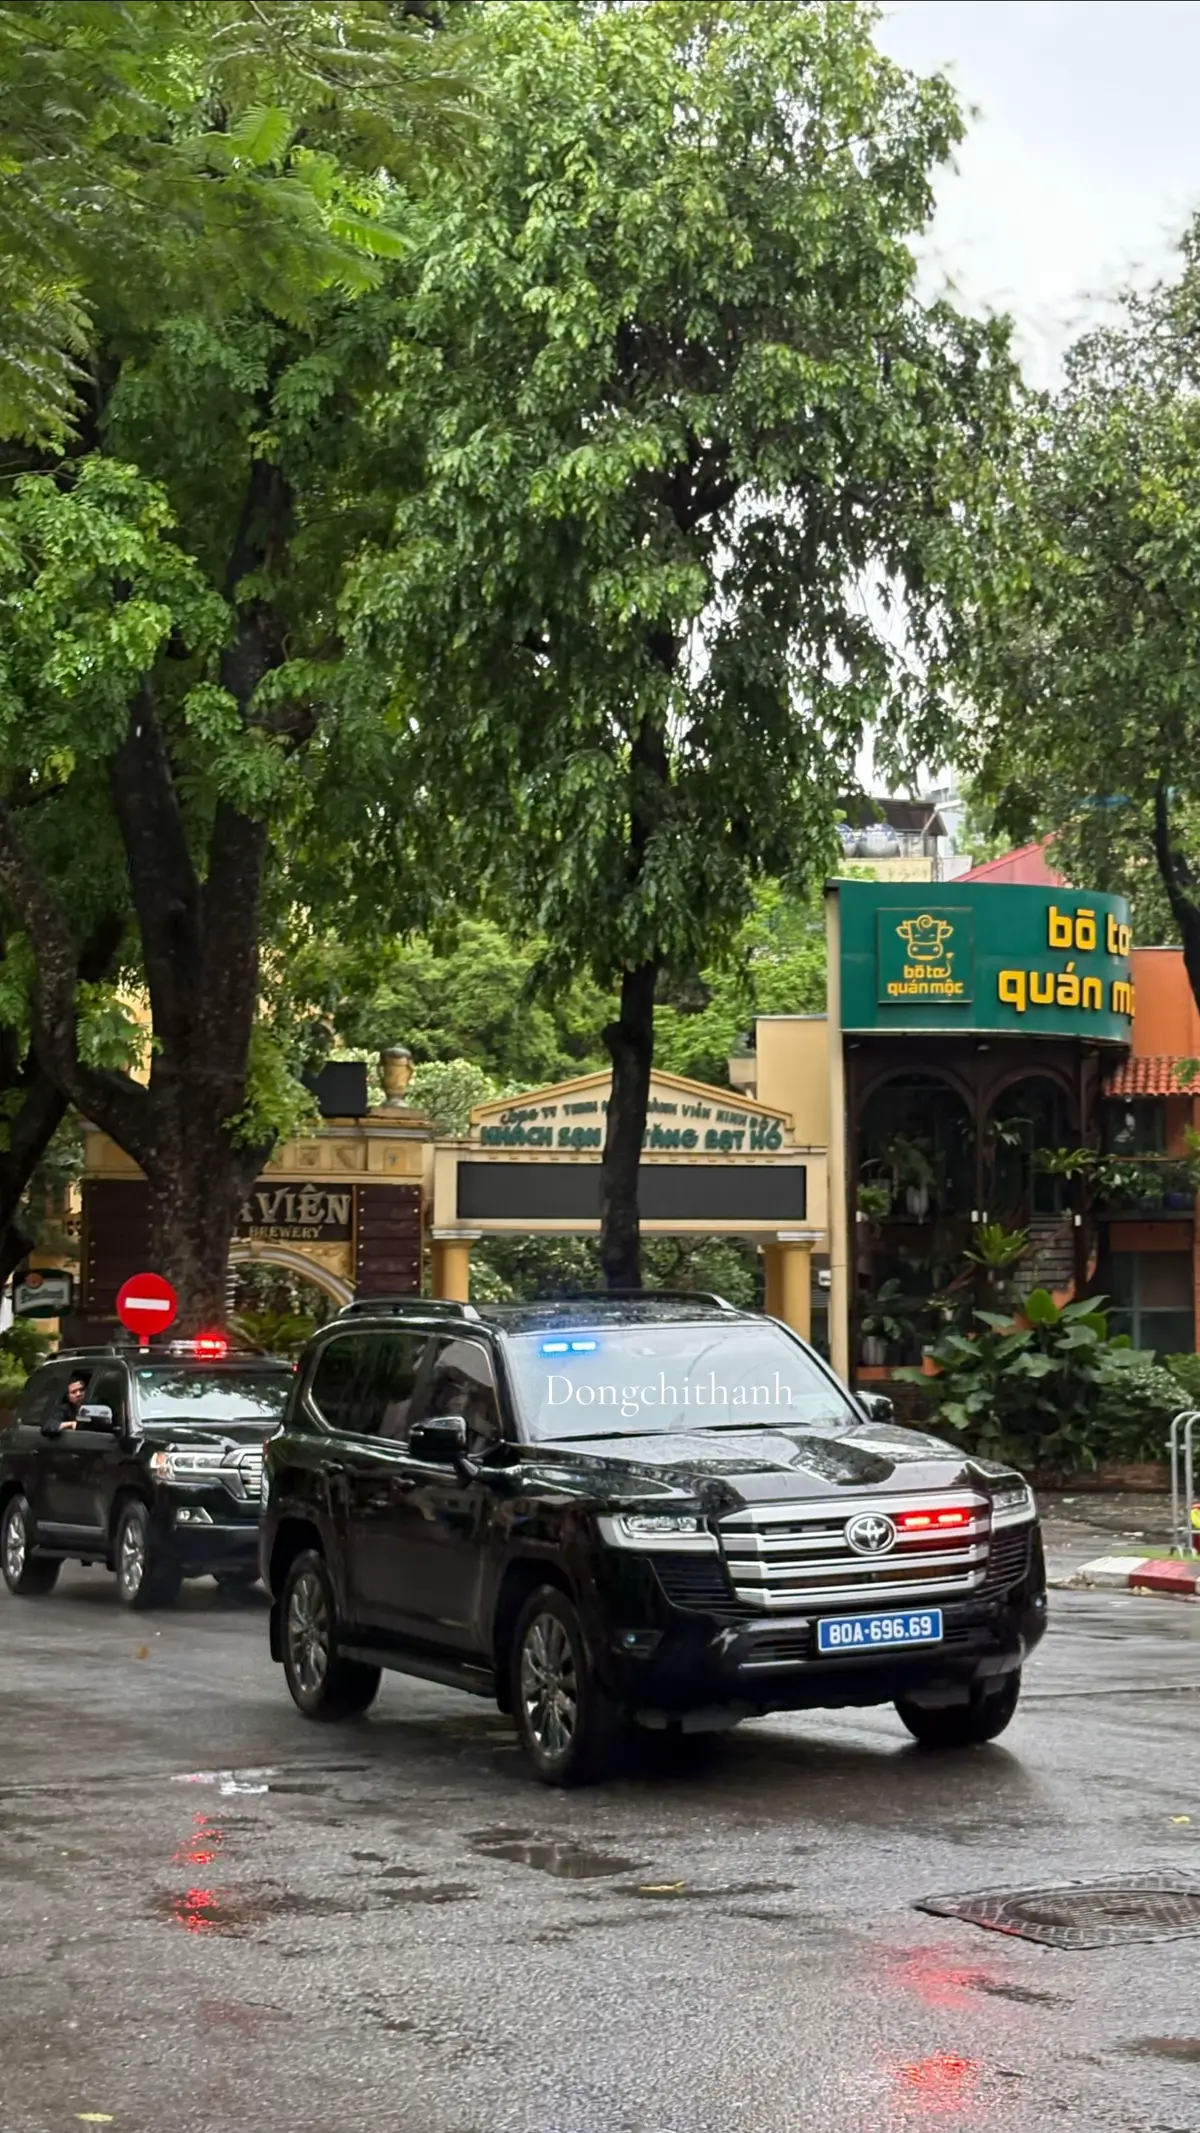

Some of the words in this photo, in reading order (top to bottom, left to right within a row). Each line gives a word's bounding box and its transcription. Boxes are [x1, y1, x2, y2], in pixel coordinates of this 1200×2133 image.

[887, 979, 928, 997] quán
[930, 978, 963, 997] mộc
[998, 961, 1102, 1012] quán
[249, 1225, 323, 1239] BREWERY
